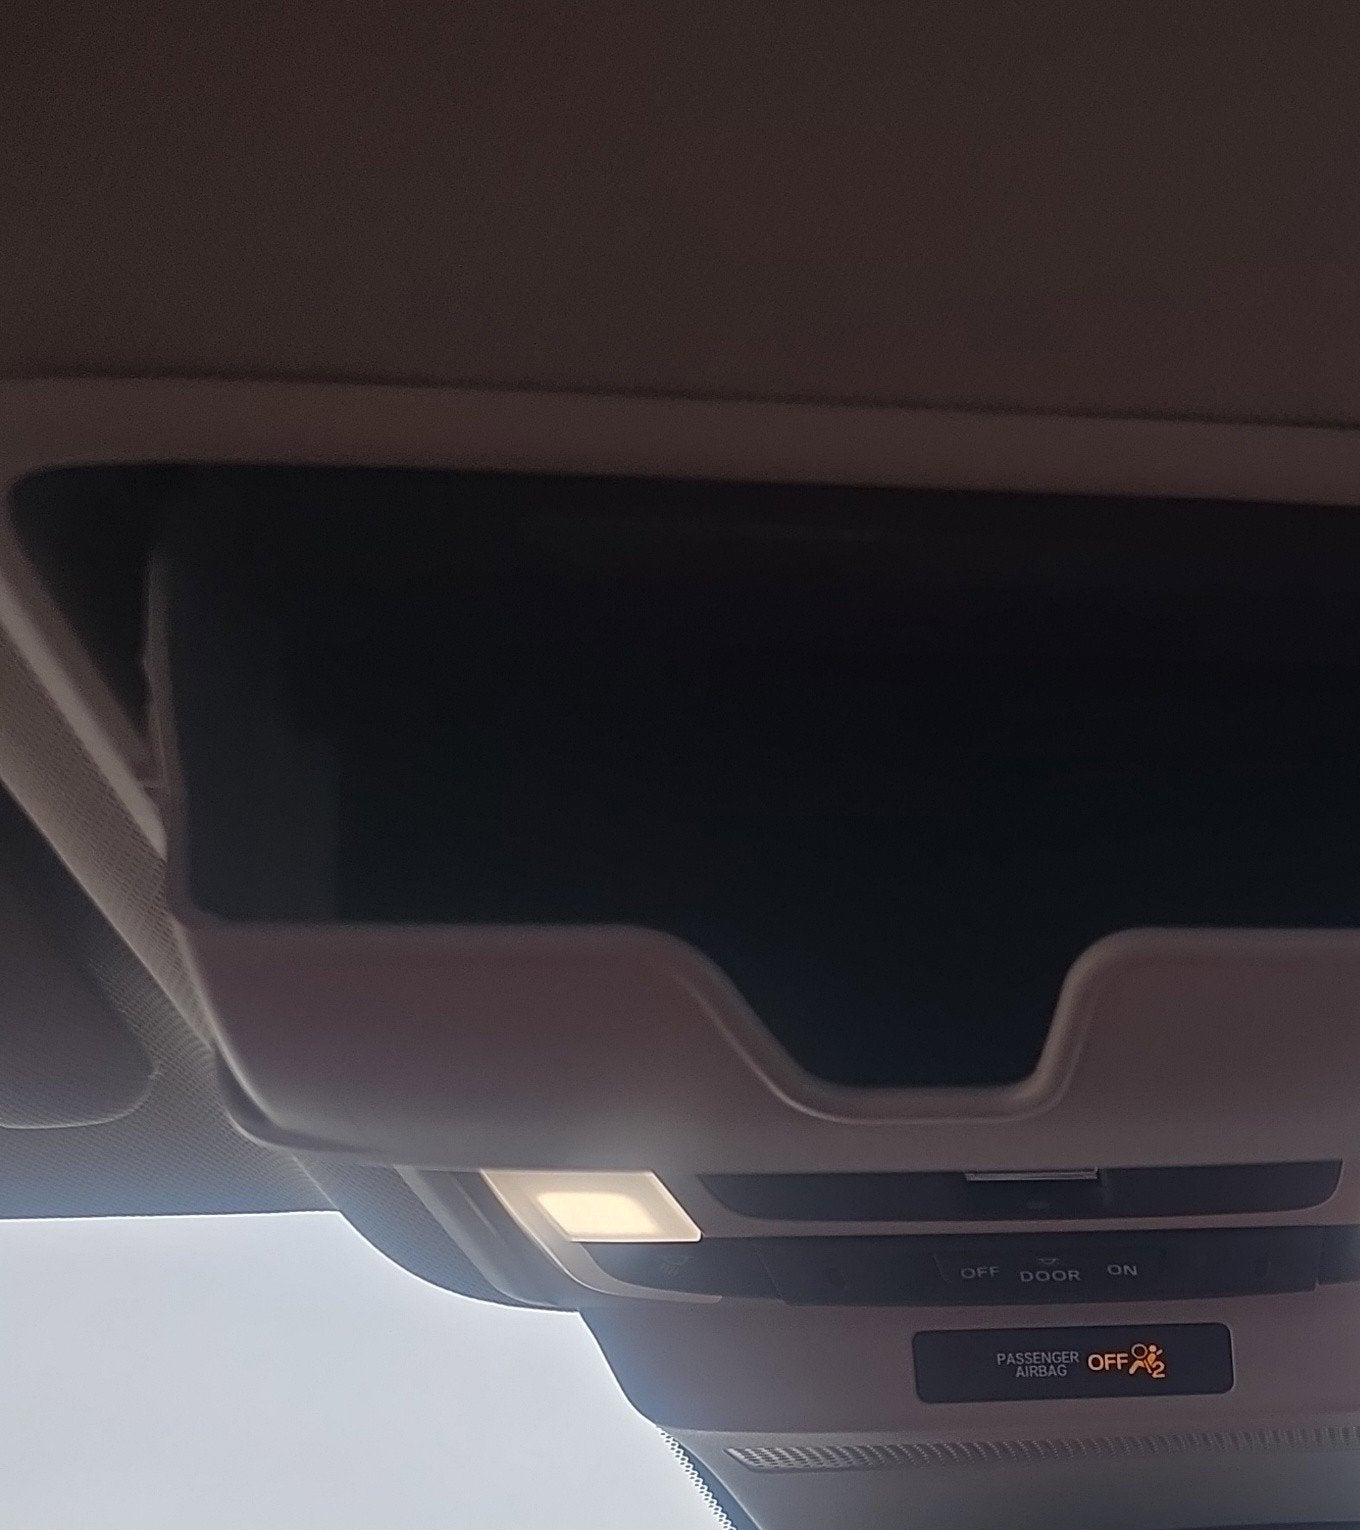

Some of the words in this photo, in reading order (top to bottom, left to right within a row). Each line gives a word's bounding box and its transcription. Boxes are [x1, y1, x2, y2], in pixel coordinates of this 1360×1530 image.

[961, 1266, 1000, 1279] OFF
[1020, 1270, 1082, 1283] DOOR
[1107, 1264, 1138, 1276] ON
[997, 1351, 1079, 1365] PASSENGER
[1087, 1353, 1128, 1371] OFF
[1015, 1364, 1068, 1378] AIRBAG
